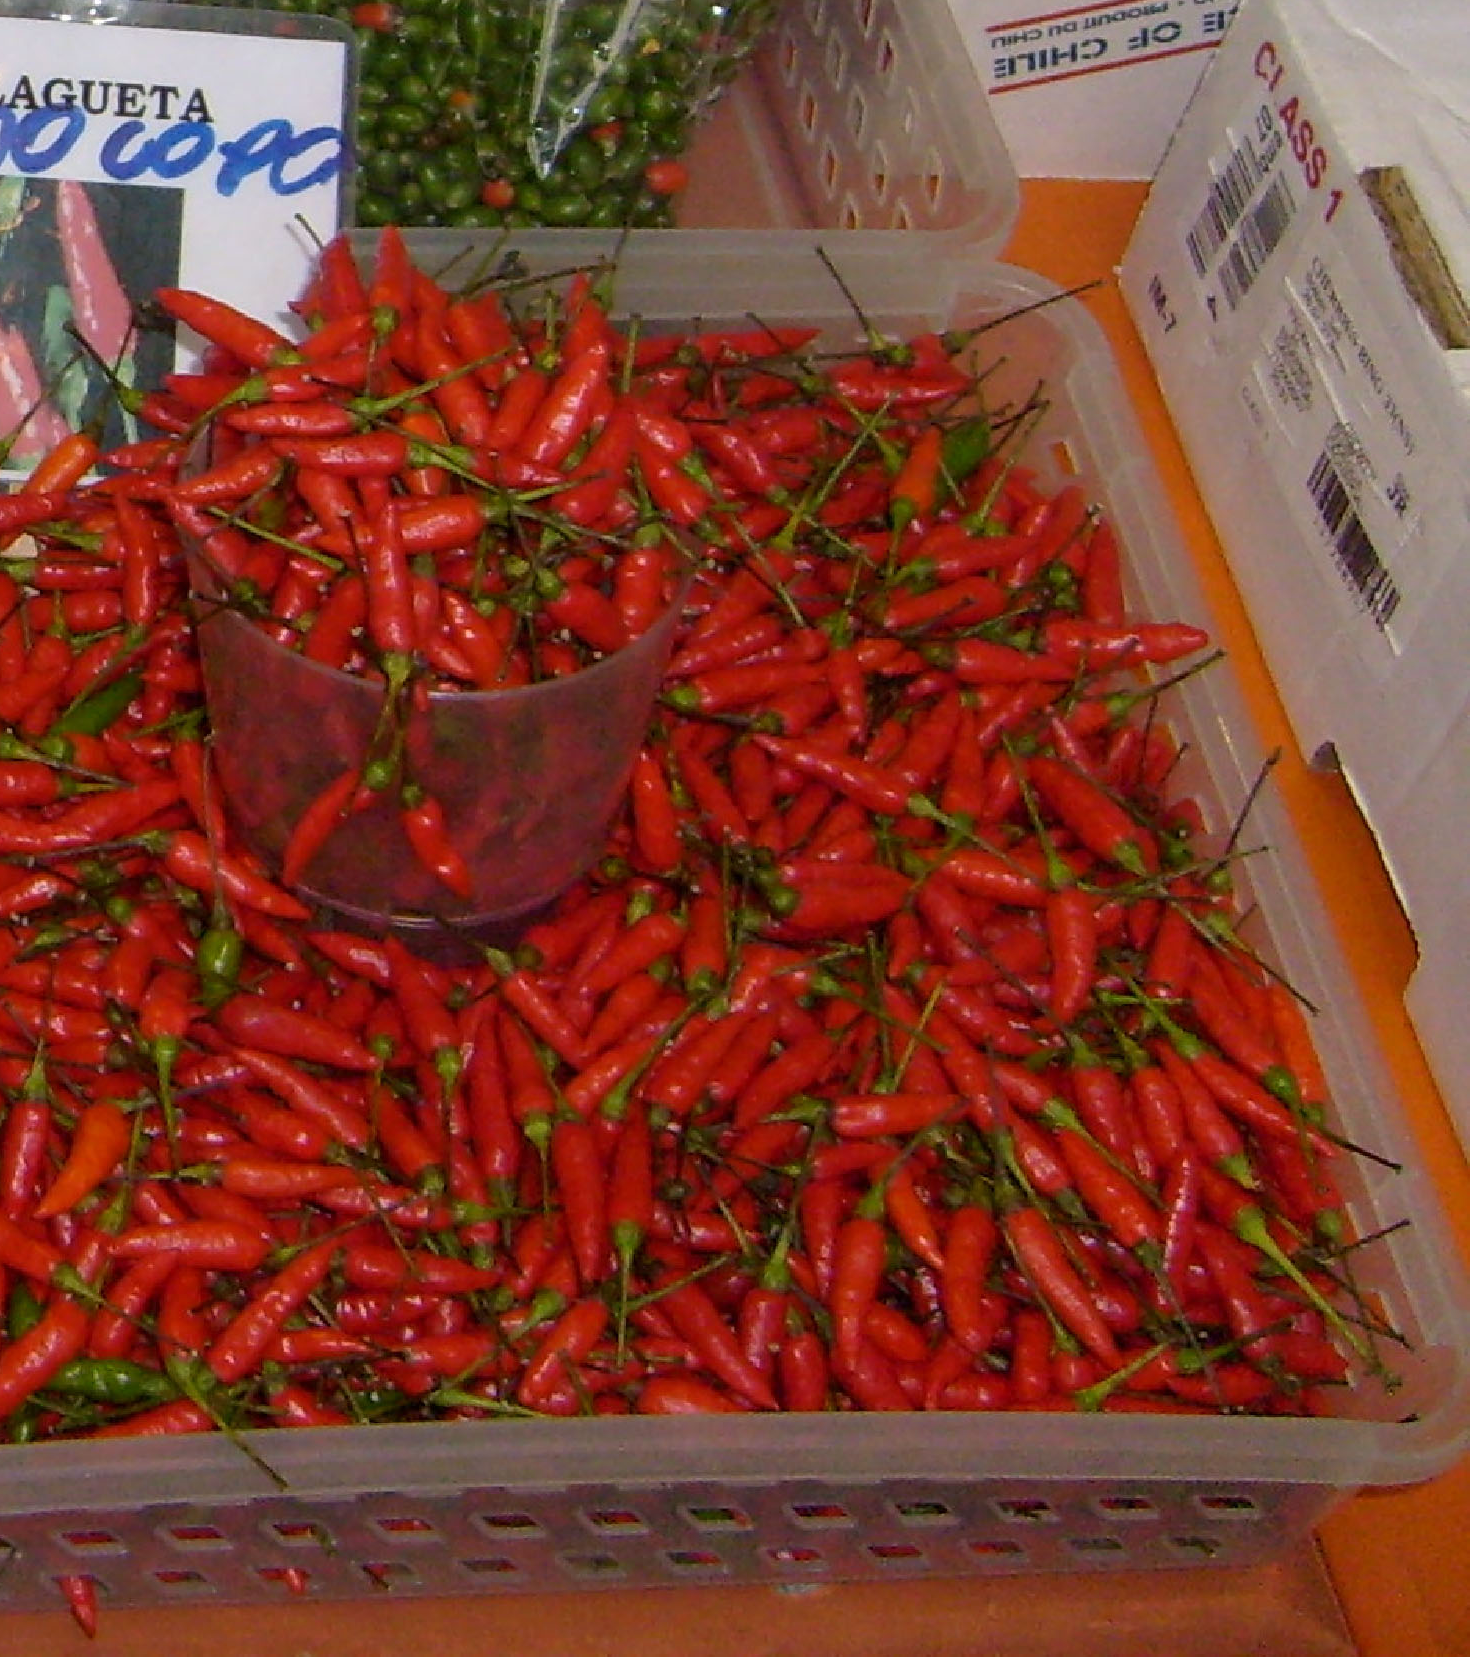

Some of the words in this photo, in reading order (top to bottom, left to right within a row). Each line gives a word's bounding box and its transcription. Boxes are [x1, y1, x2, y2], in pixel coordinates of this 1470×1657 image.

[1047, 20, 1078, 38] DU
[1084, 1, 1169, 30] PRODUIT
[1127, 20, 1182, 51] OF
[993, 37, 1109, 80] CHILE
